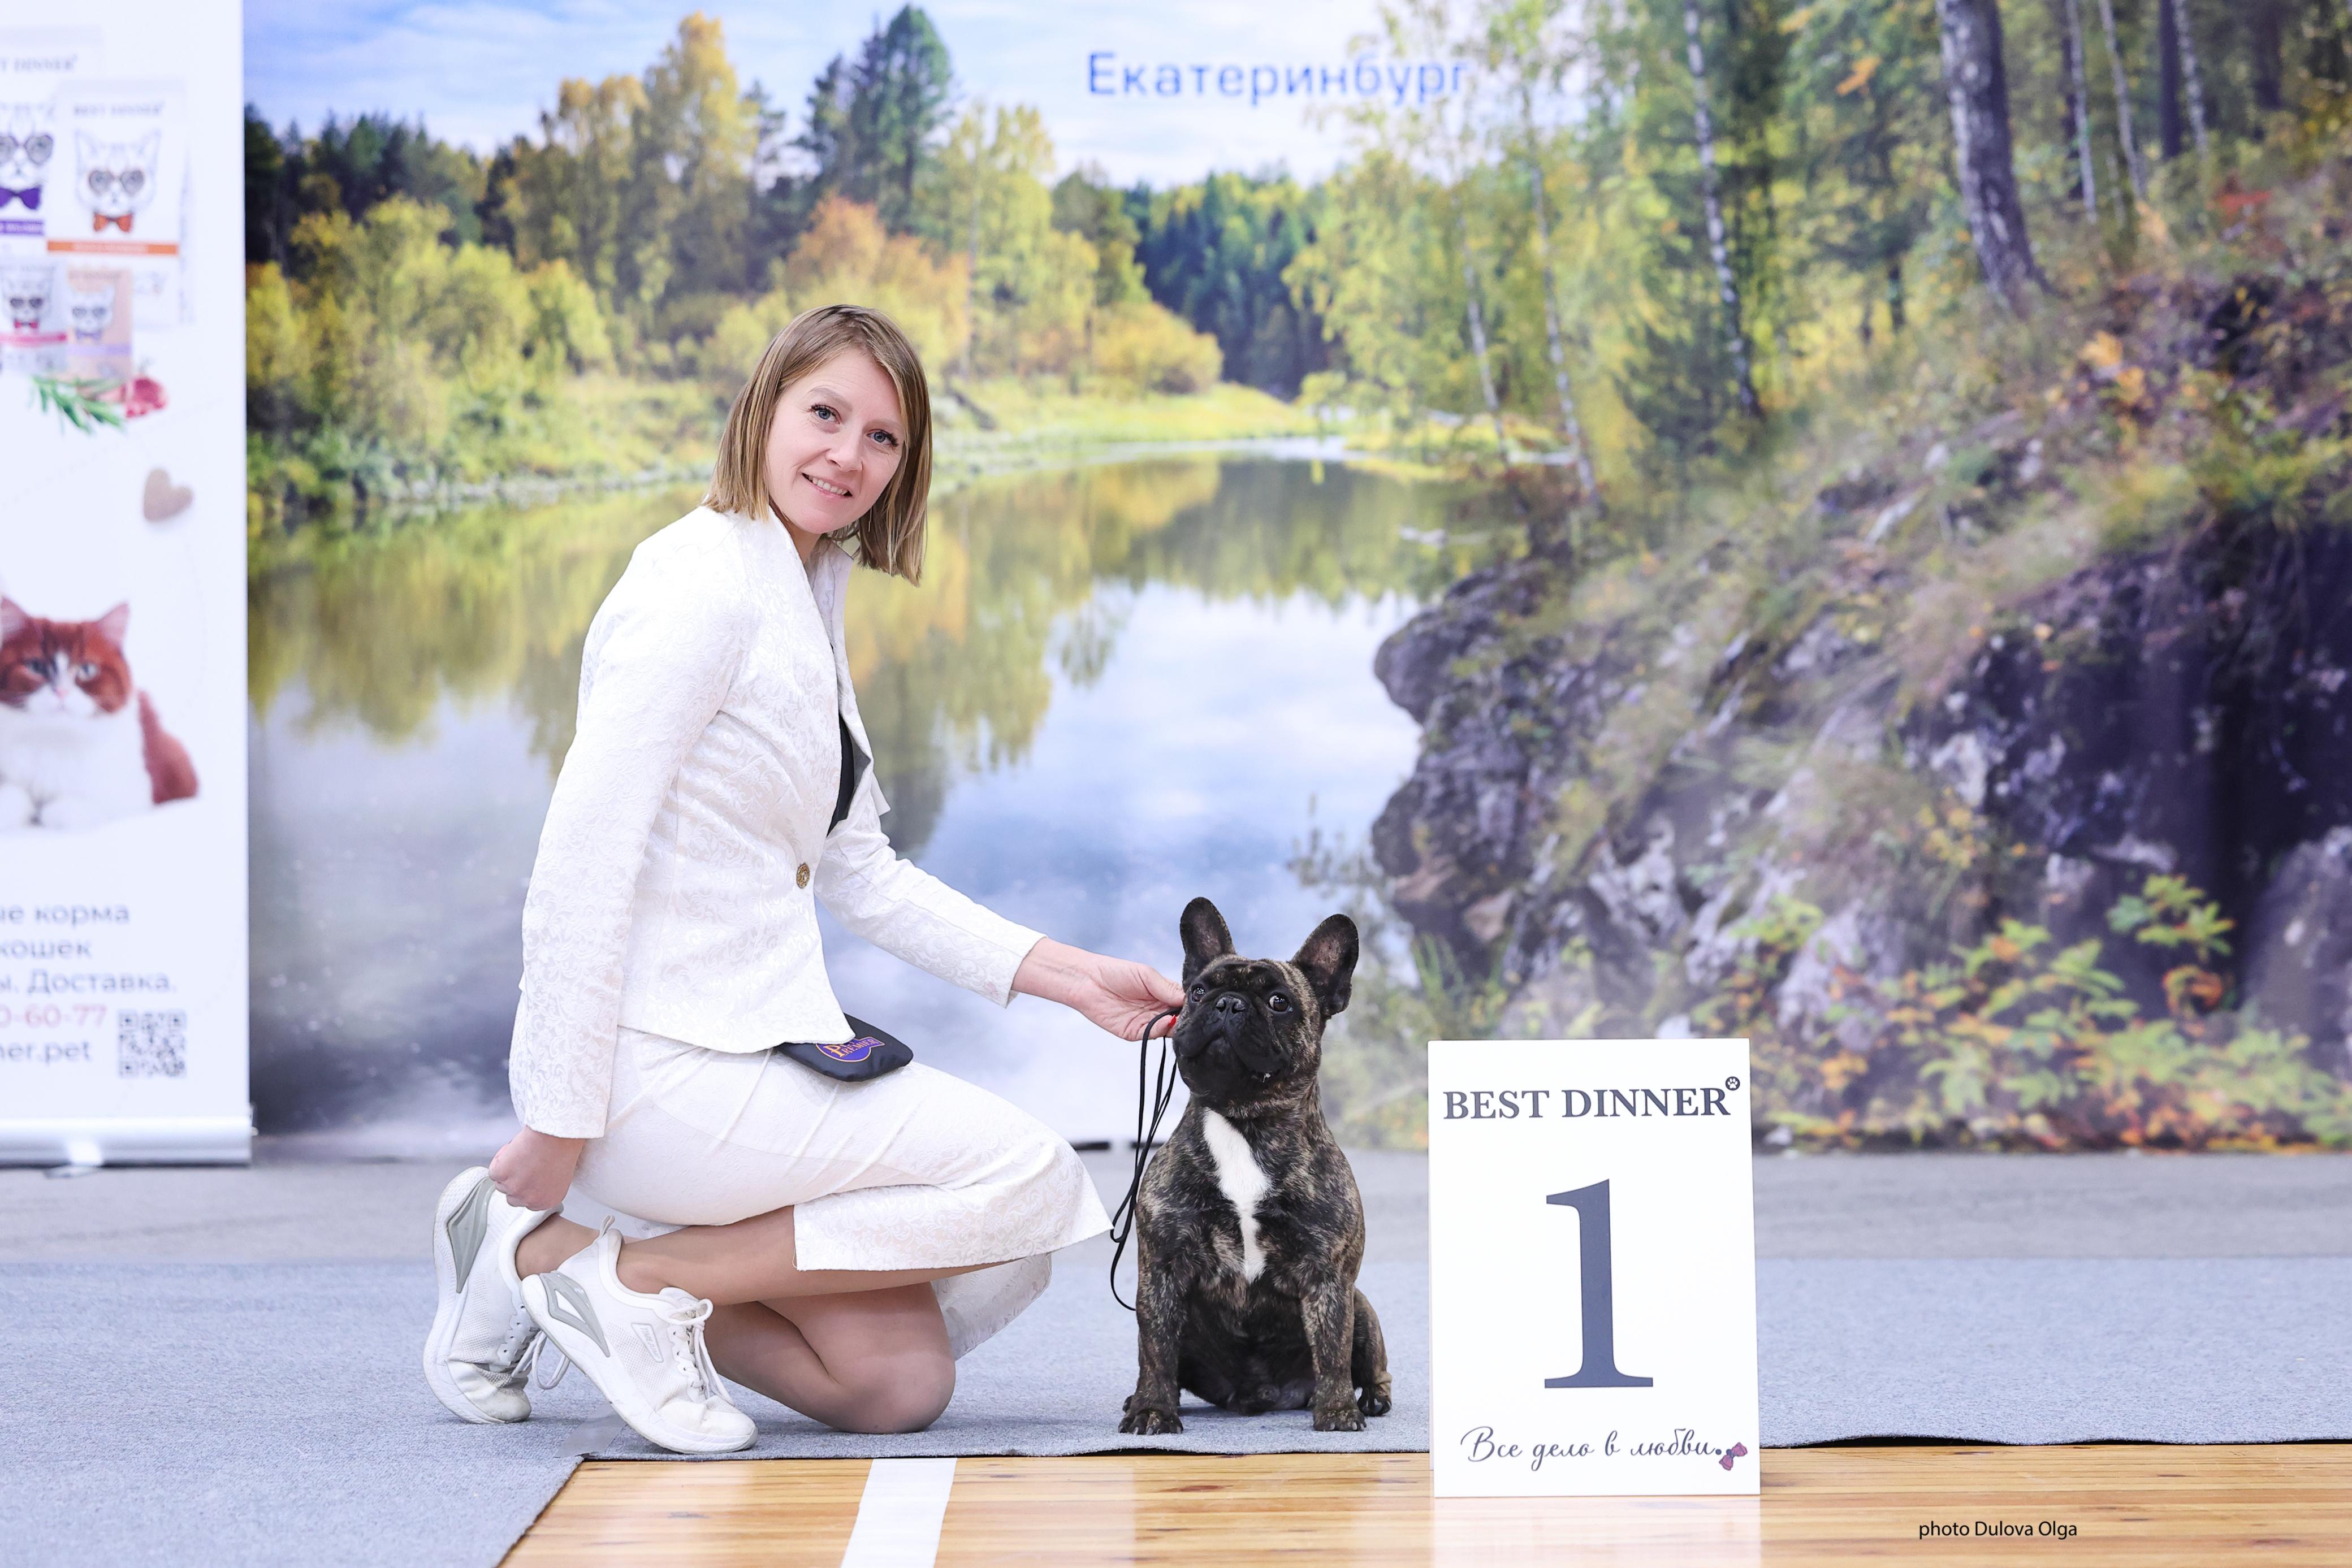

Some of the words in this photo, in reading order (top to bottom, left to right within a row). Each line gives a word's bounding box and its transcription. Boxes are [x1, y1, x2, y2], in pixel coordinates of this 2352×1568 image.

[1088, 50, 1468, 108] Екатеринбург
[35, 904, 130, 929] корма
[0, 939, 92, 959] кошек
[28, 968, 178, 995] Доставка.
[1443, 1090, 1550, 1119] BEST
[1561, 1087, 1731, 1117] DINNER
[1544, 1179, 1653, 1388] 1
[1460, 1426, 1523, 1462] Все
[1530, 1442, 1595, 1471] дело
[1604, 1430, 1620, 1456] в
